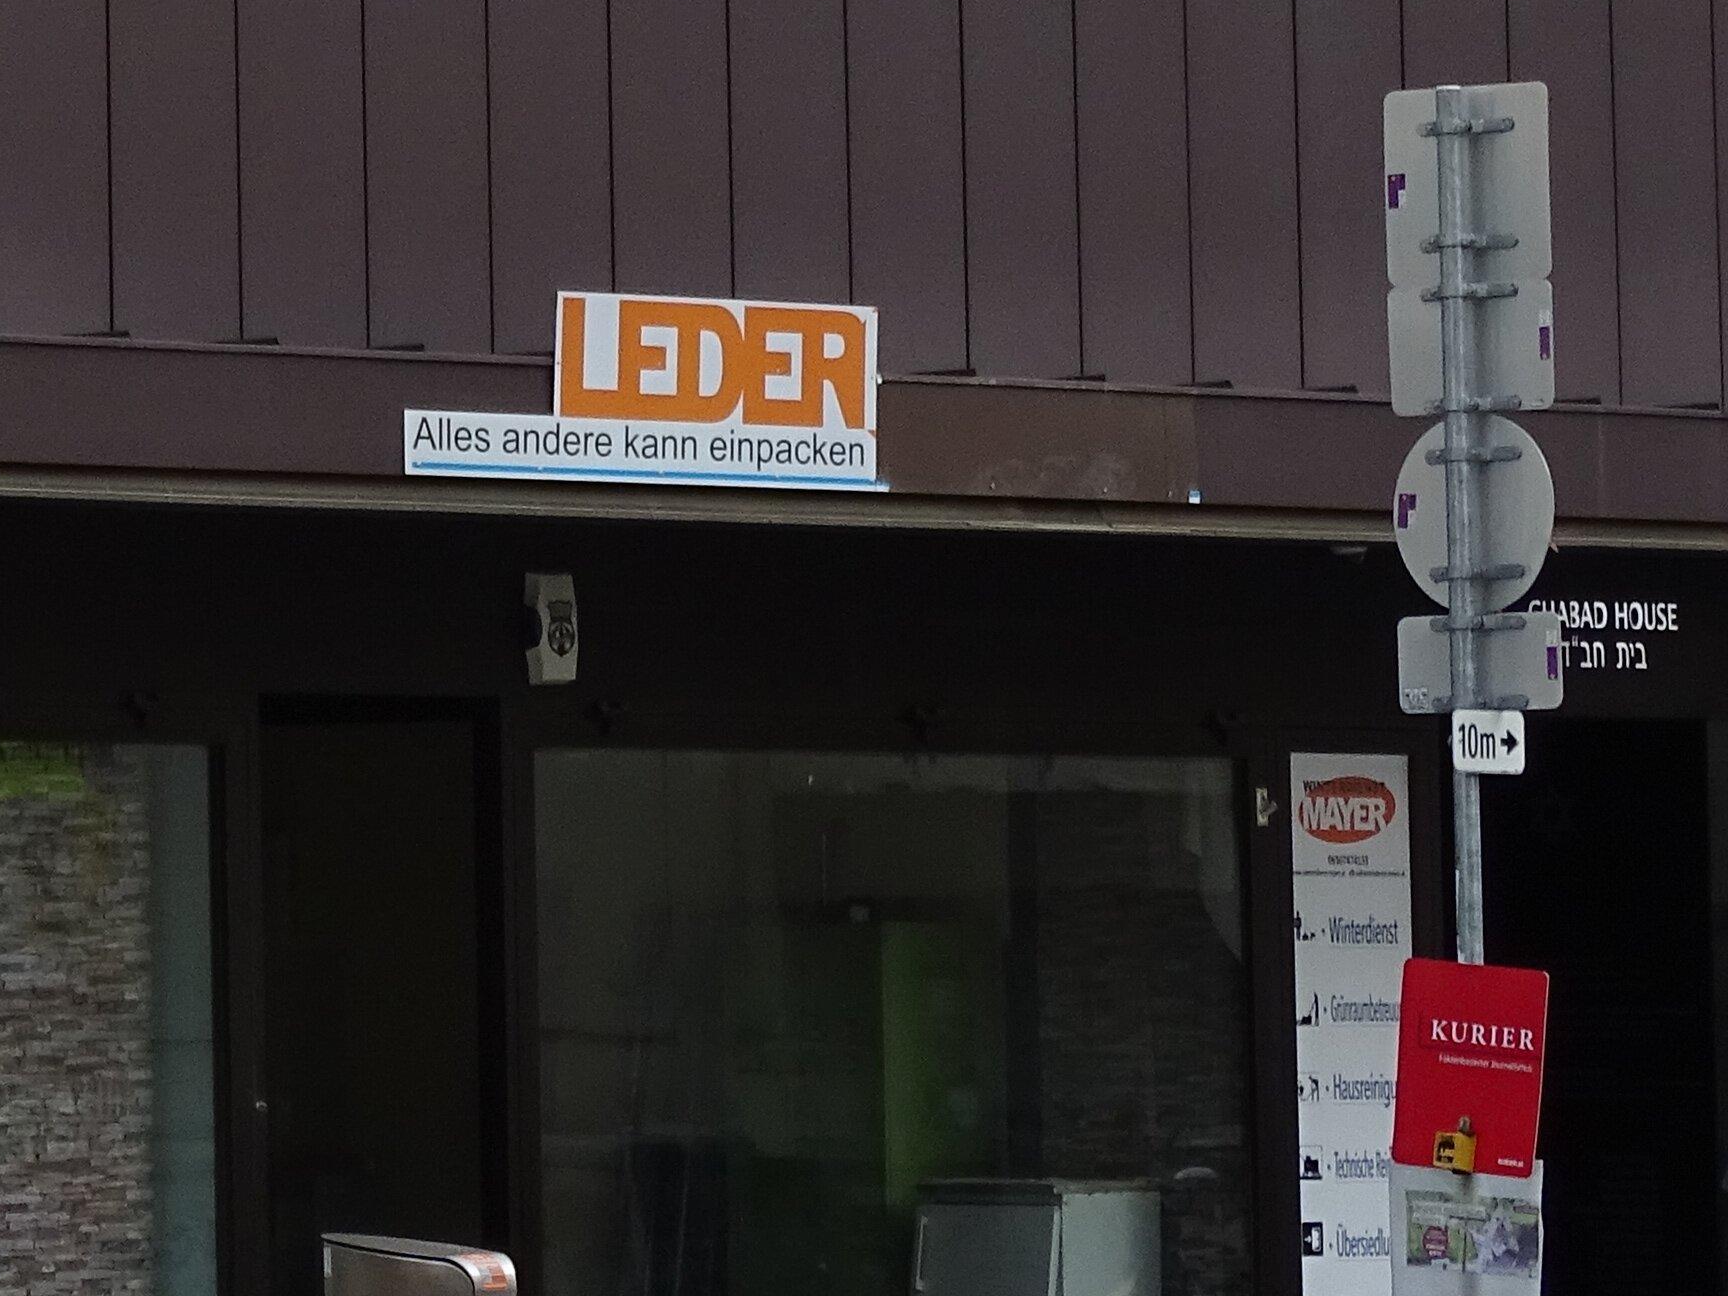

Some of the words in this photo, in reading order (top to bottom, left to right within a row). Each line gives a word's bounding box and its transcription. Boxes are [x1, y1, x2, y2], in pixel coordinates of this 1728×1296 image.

[560, 297, 866, 430] LEDER
[412, 416, 491, 452] Alles
[502, 421, 612, 458] andere
[624, 425, 698, 461] kann
[709, 430, 865, 472] einpacken
[1614, 601, 1679, 631] HOUSE
[1616, 641, 1648, 670] בית
[1458, 722, 1496, 760] 10m
[1302, 795, 1387, 832] MAYER
[1329, 914, 1399, 945] Winterdienst
[1430, 1018, 1534, 1051] KURIER
